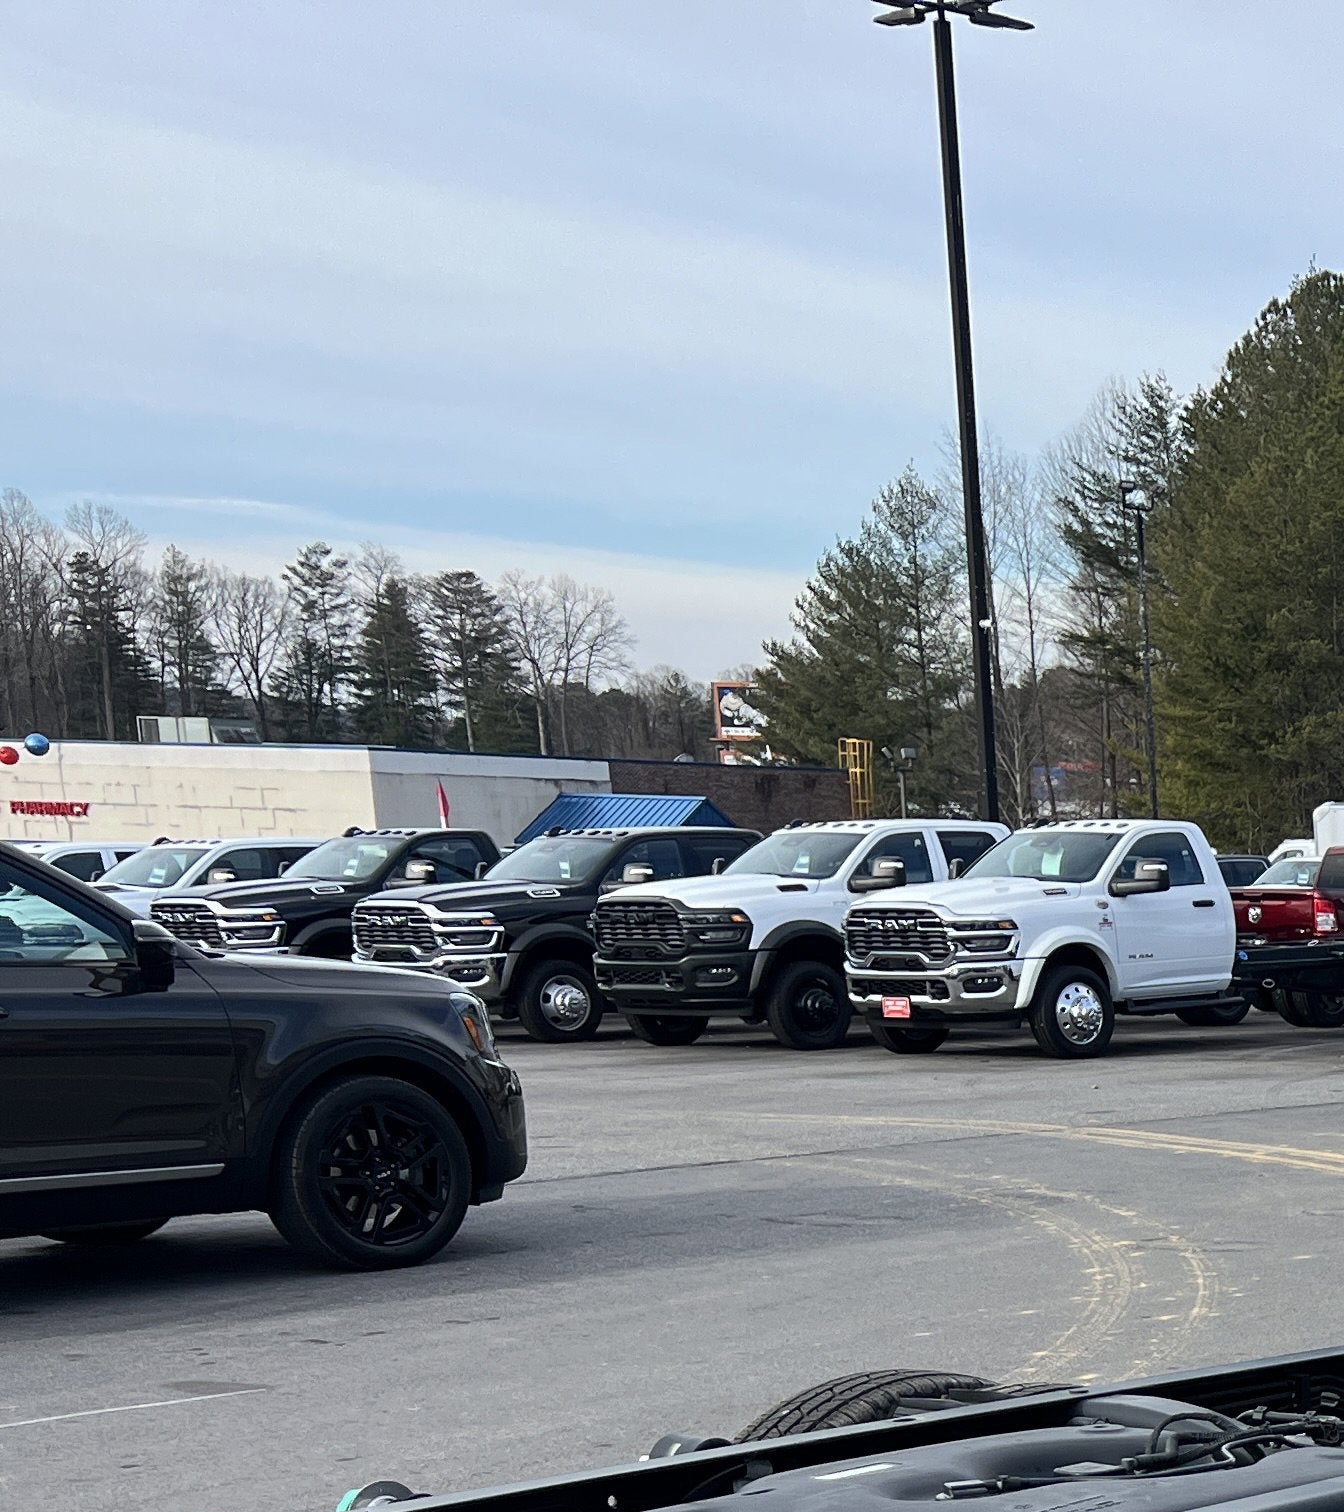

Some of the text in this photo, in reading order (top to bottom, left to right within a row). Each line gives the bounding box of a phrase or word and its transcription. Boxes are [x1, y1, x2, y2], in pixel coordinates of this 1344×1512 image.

[10, 800, 89, 816] PHARMACY
[367, 915, 409, 926] RAM
[613, 911, 656, 923] RAM
[863, 918, 916, 930] RAM
